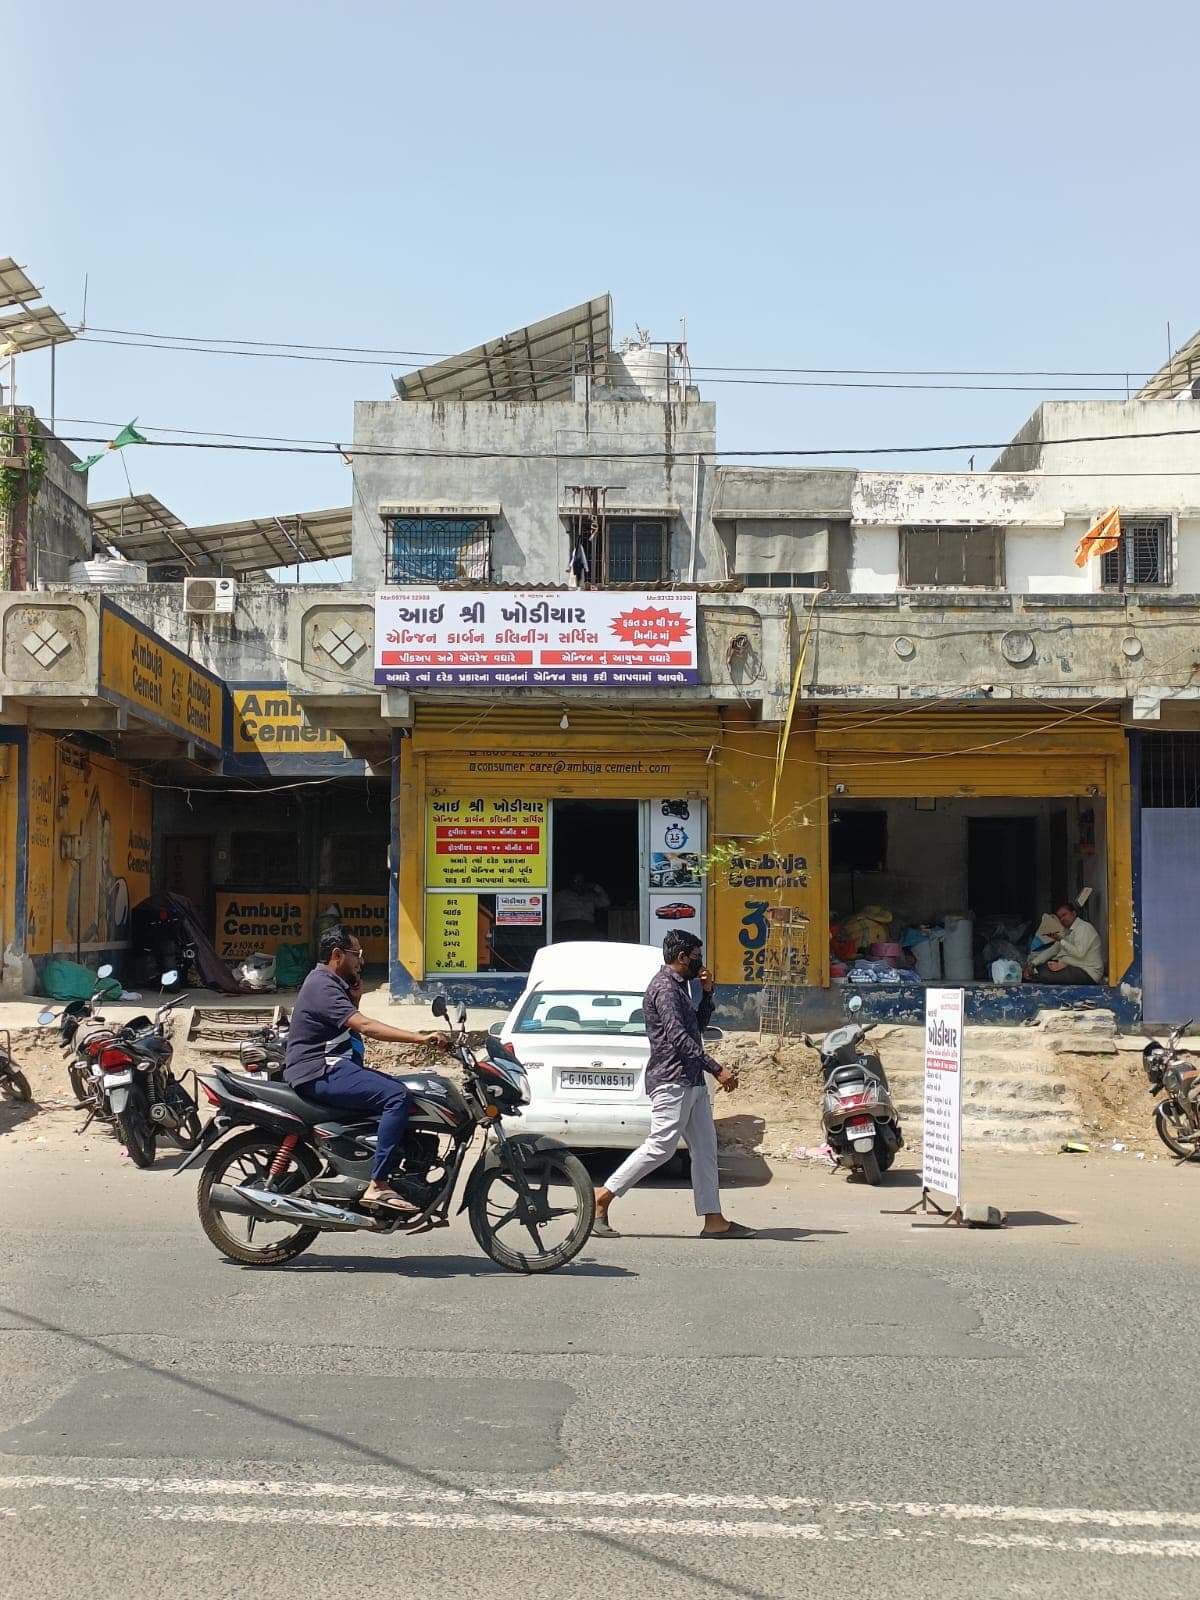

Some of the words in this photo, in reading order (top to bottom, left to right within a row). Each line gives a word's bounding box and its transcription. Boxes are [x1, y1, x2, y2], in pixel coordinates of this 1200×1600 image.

[399, 603, 445, 624] આઈ
[459, 601, 485, 624] શ્રી
[501, 601, 586, 624] ખોડીયાર
[386, 629, 437, 644] એન્જિન
[447, 628, 485, 644] કાર્બન
[558, 628, 599, 644] સર્વિસ
[131, 633, 163, 681] Ambuja
[399, 652, 432, 663] પીકઅપ
[437, 652, 453, 663] અને
[459, 652, 488, 663] એવરેજ
[494, 652, 516, 663] વધારે
[561, 651, 594, 663] એન્જિન
[599, 651, 607, 665] નું
[649, 652, 671, 663] વધારે
[132, 665, 163, 707] Cement
[386, 671, 411, 682] અમારે
[436, 671, 453, 682] દરેક
[458, 674, 490, 682] પ્રકારના
[533, 671, 566, 682] એન્જિન
[571, 673, 587, 683] સાફ
[593, 671, 607, 682] કરી
[613, 672, 652, 682] આપવામાં
[187, 671, 211, 711] Ambuja
[187, 698, 211, 734] Cement
[469, 798, 484, 813] શ્રી
[493, 798, 544, 813] ખોડીયાર
[432, 814, 460, 823] એન્જિન
[464, 814, 485, 823] કાર્બન
[670, 833, 680, 841] 15
[224, 902, 302, 922] Ambuja
[223, 919, 303, 936] Cement
[738, 900, 771, 950] 3
[927, 1018, 958, 1048] ખોડીયાર
